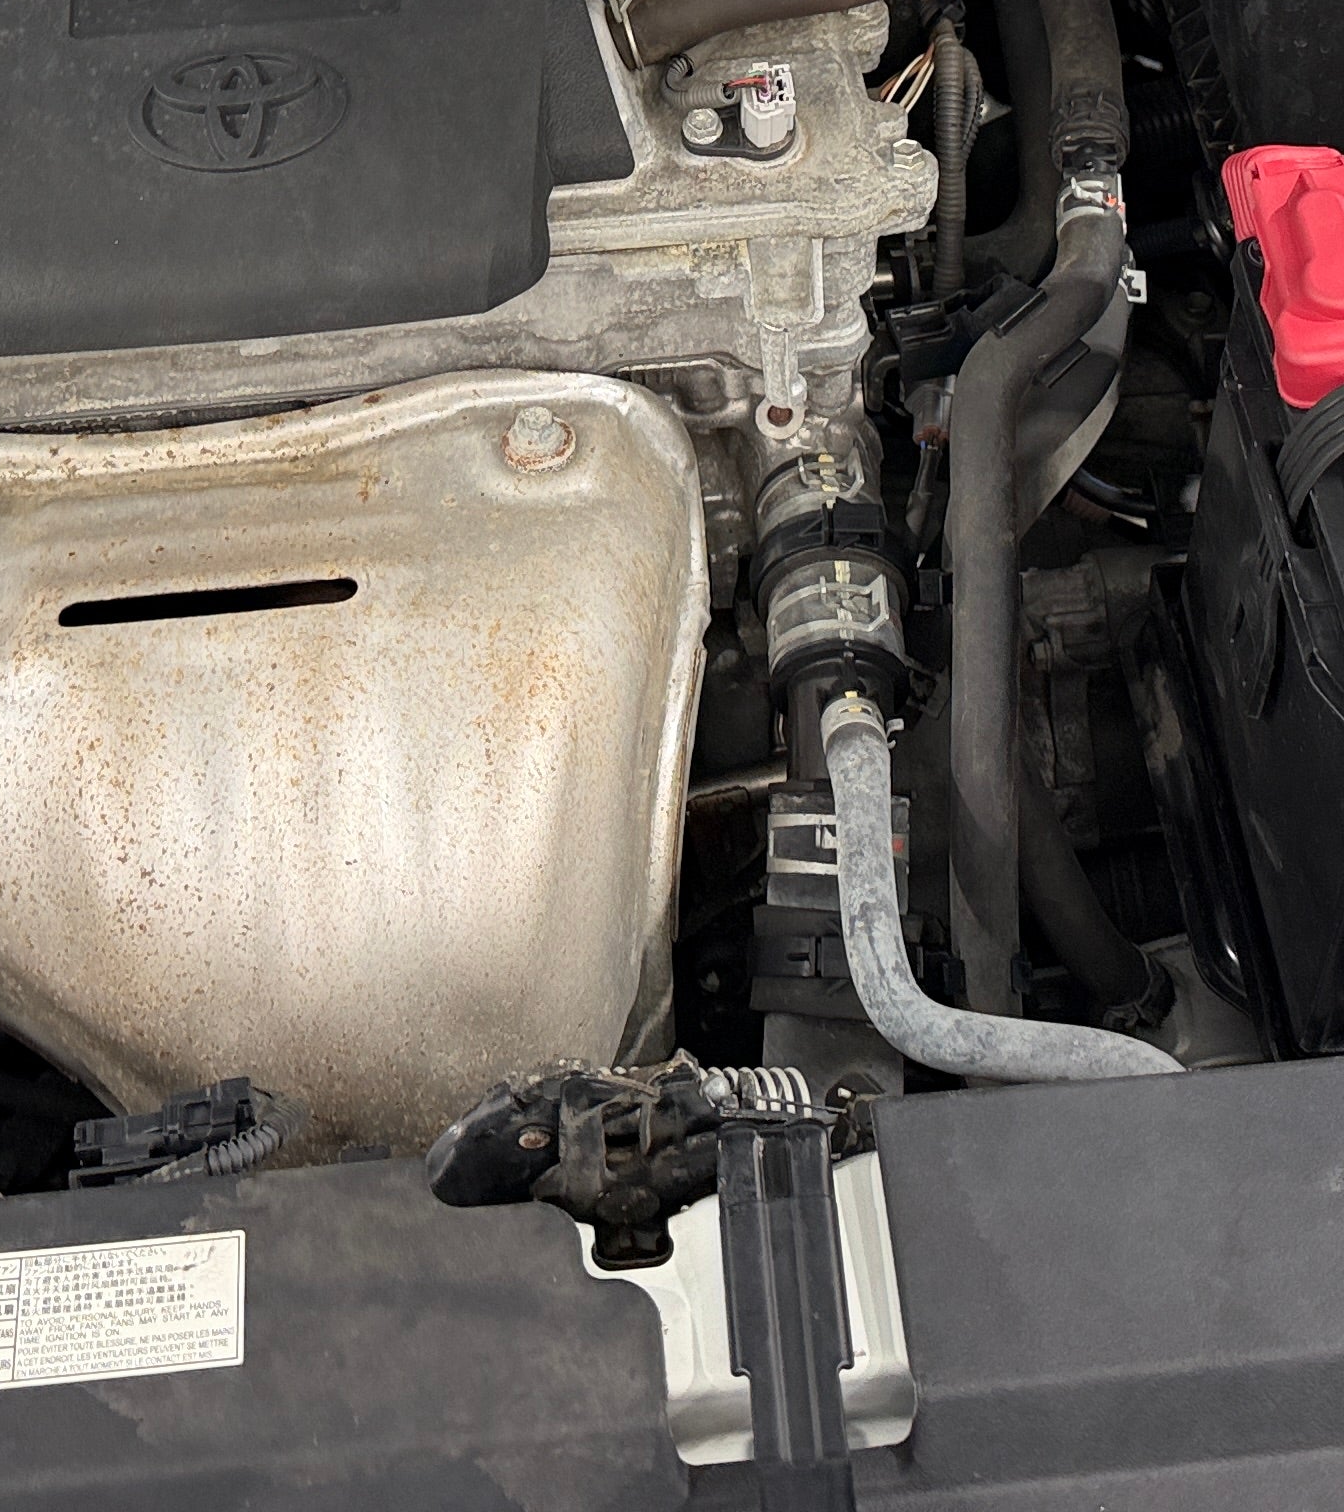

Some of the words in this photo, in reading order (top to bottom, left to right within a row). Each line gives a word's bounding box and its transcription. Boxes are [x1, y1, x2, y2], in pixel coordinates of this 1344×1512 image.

[19, 1326, 44, 1336] AWAY
[48, 1323, 76, 1334] FROM
[139, 1315, 157, 1325] MAY
[162, 1311, 191, 1323] START
[195, 1310, 206, 1319] AT
[210, 1307, 230, 1317] ANY
[20, 1318, 33, 1328] TO
[70, 1310, 118, 1323] PERSONAL
[161, 1304, 185, 1315] KEEP
[189, 1300, 222, 1311] HANDS
[17, 1346, 40, 1355] POUR
[69, 1340, 94, 1351] TOUTE
[139, 1335, 150, 1344] NE
[151, 1333, 167, 1343] PAS
[168, 1330, 195, 1342] POSER
[196, 1328, 210, 1339] LES
[18, 1335, 41, 1346] TIME
[45, 1331, 88, 1343] IGNITION
[91, 1329, 101, 1339] IS
[17, 1369, 27, 1378] EN
[28, 1366, 61, 1377] MARCHE
[90, 1360, 125, 1371] MOMENT
[134, 1358, 145, 1368] LE
[145, 1354, 182, 1367] CONTACT
[182, 1353, 197, 1362] EST
[23, 1357, 38, 1367] CET
[76, 1353, 91, 1362] LES
[93, 1346, 149, 1360] VENTILATEURS
[149, 1343, 186, 1354] PEUVENT
[186, 1341, 197, 1351] SE
[198, 1338, 230, 1349] METTRE
